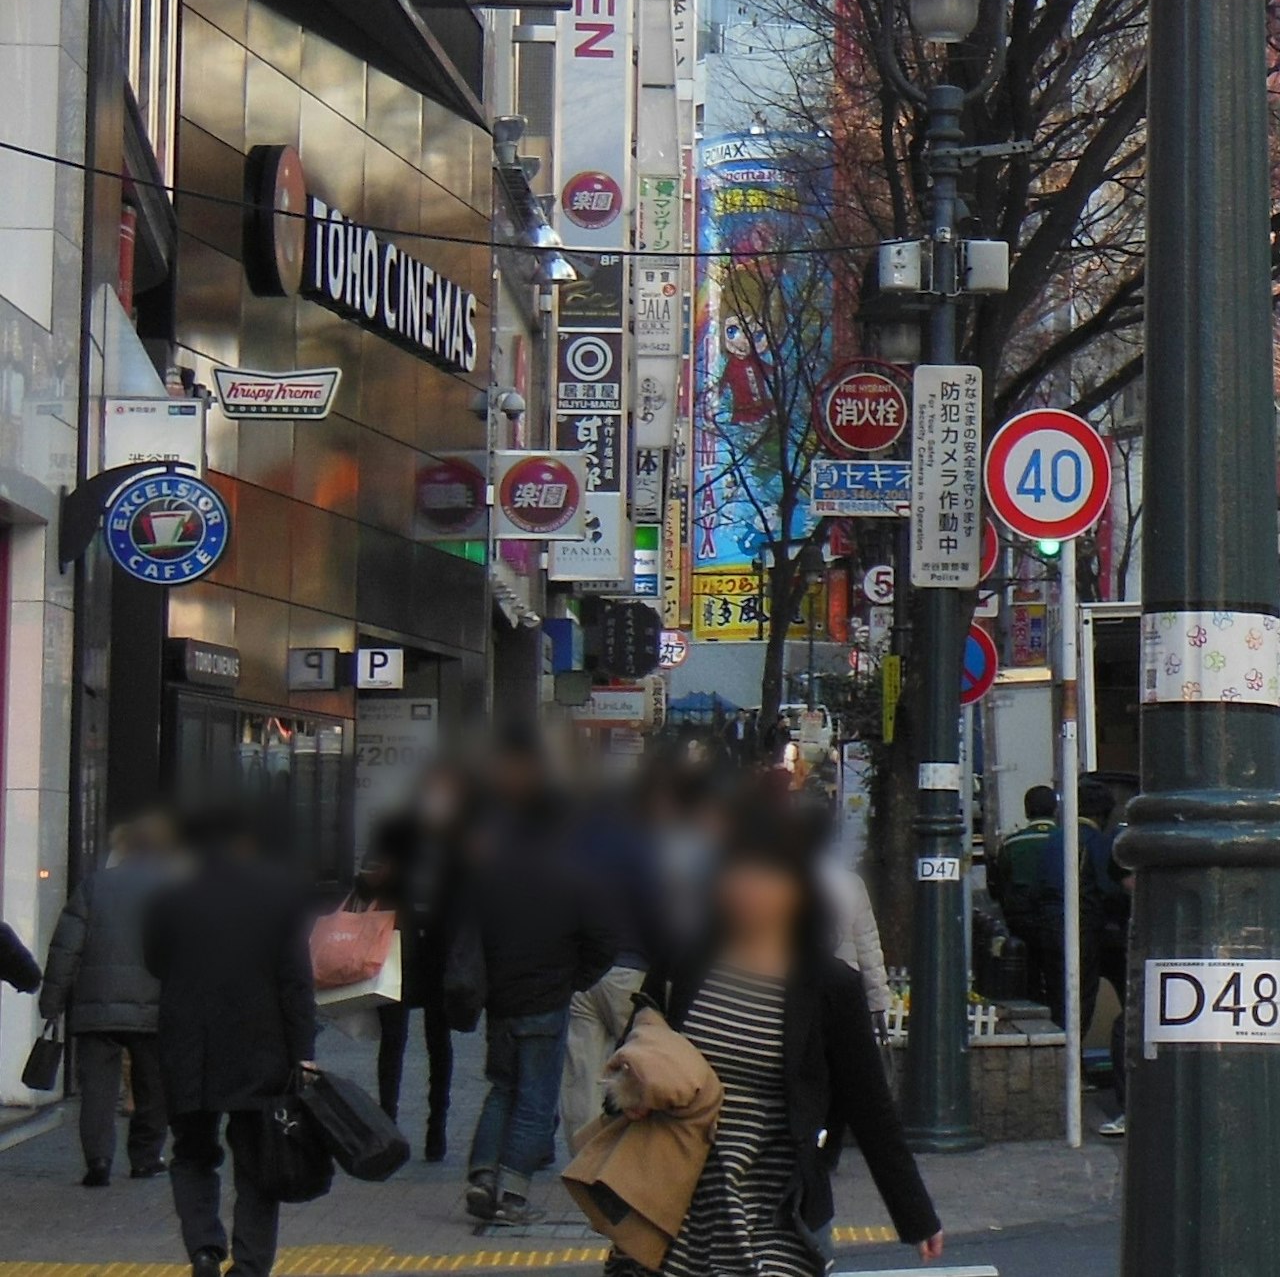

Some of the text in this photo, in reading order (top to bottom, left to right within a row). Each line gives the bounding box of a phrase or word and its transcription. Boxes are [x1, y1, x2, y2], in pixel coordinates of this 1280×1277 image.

[572, 191, 614, 212] 楽園
[600, 255, 620, 267] 8F
[311, 195, 478, 374] TOHO CINEMAS
[226, 381, 323, 402] Krispy Kreme
[835, 397, 900, 427] 消火栓
[938, 381, 960, 556] 防犯カメラ作動中
[1016, 448, 1082, 503] 40
[113, 478, 223, 532] EXCELSIOR
[513, 483, 568, 509] 楽園
[561, 546, 612, 556] PANDA
[873, 571, 894, 599] 5
[930, 573, 960, 581] Police
[369, 651, 388, 679] P
[920, 861, 956, 878] D47
[1159, 971, 1279, 1028] D48
